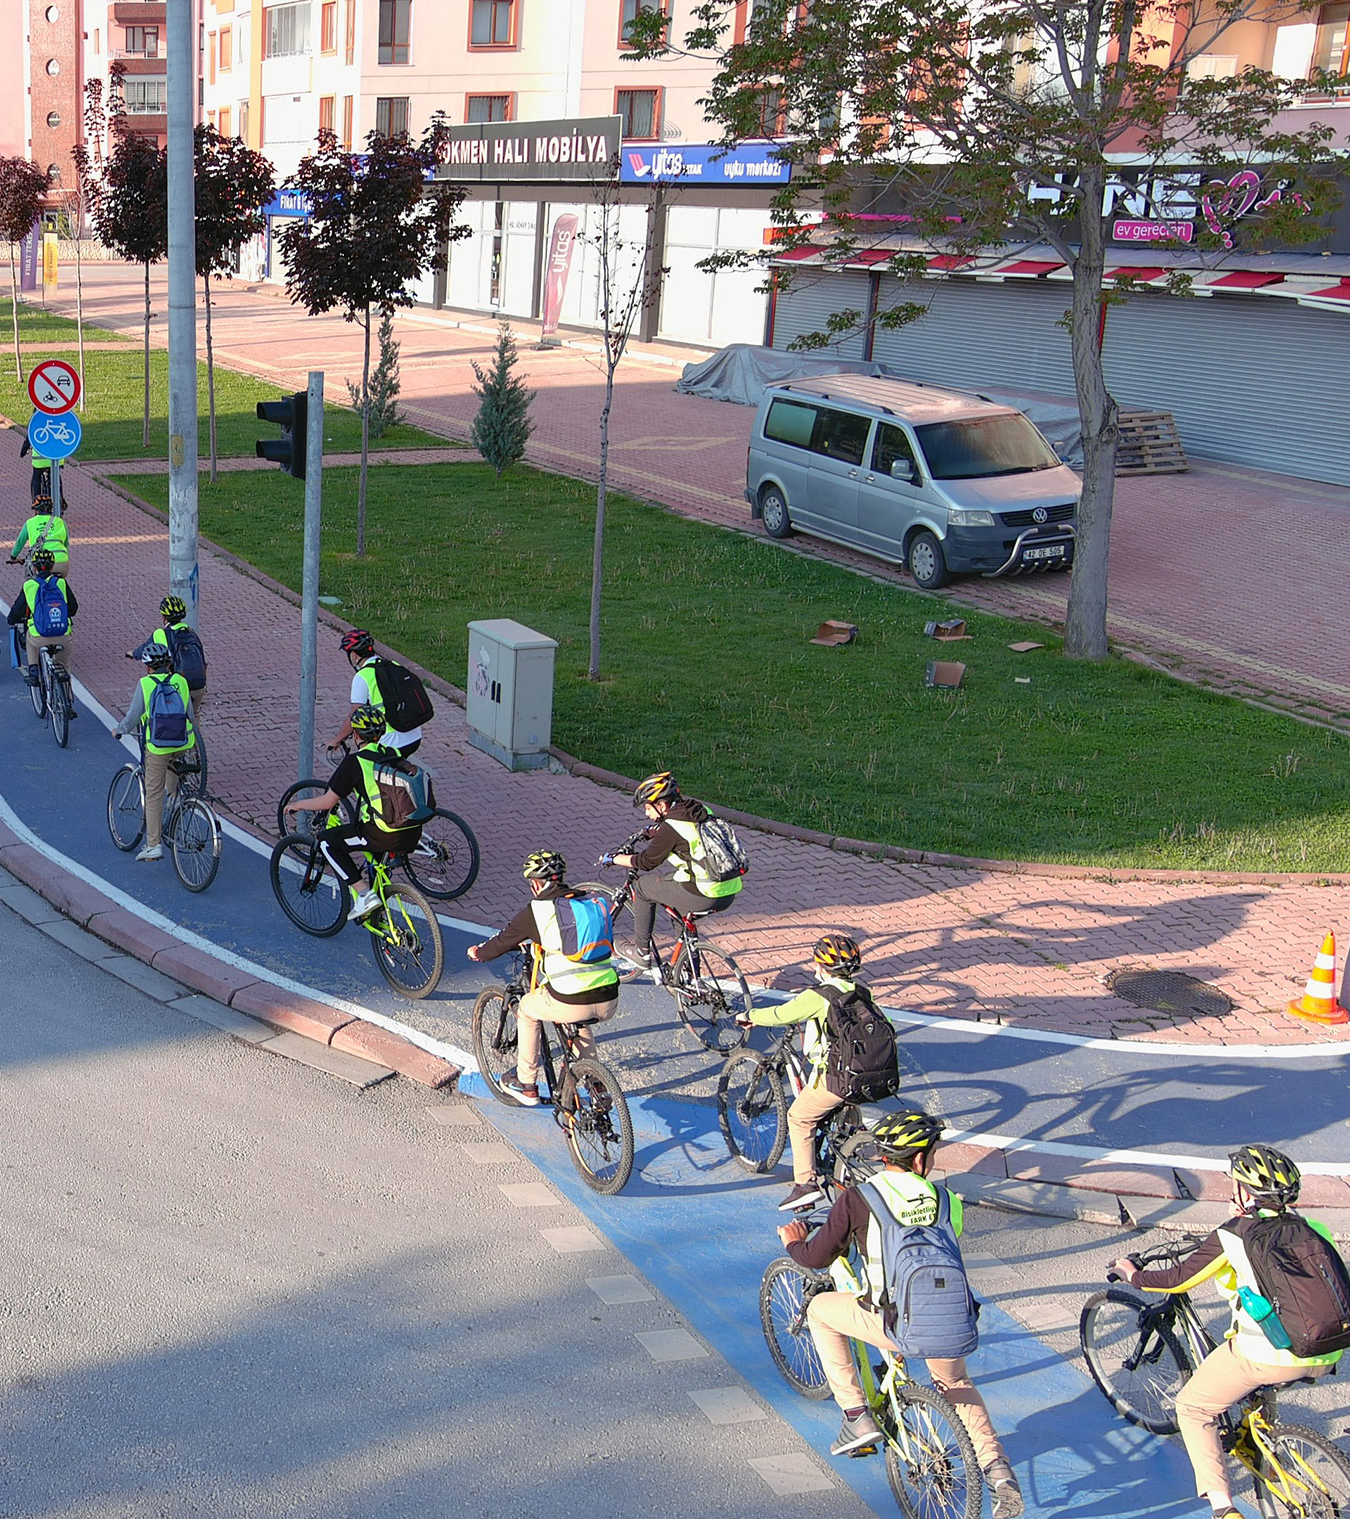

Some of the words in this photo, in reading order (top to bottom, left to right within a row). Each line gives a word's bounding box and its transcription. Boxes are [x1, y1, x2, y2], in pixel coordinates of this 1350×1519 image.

[494, 138, 529, 163] HALI
[535, 128, 607, 163] MOBİLYA
[724, 160, 744, 179] uyku
[746, 160, 782, 177] merkezi
[1117, 225, 1131, 236] ev
